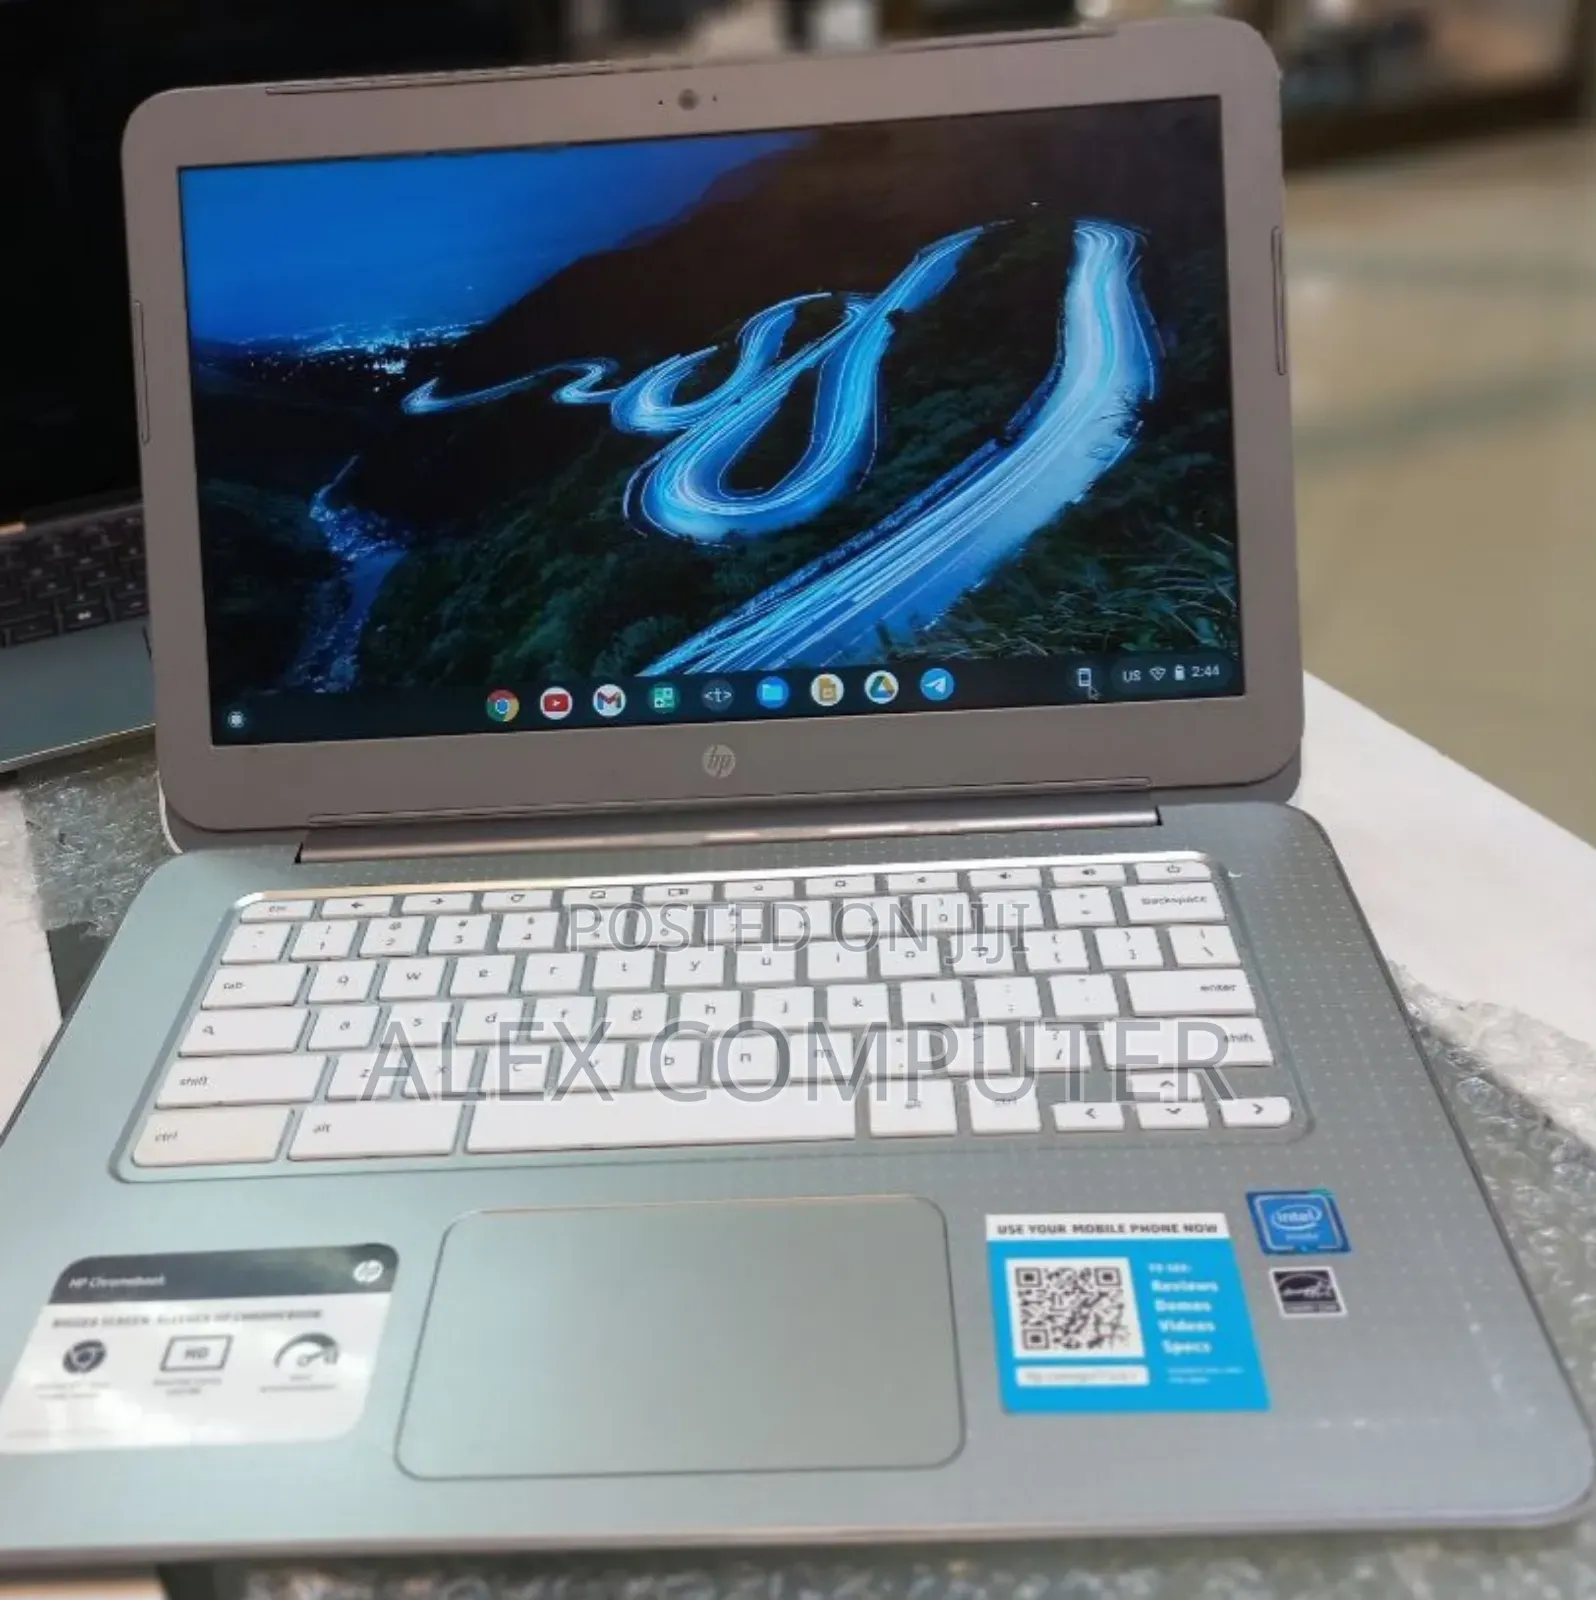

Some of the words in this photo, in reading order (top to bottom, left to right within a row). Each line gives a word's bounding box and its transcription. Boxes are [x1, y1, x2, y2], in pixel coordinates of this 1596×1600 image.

[1122, 669, 1142, 683] US
[1191, 664, 1220, 678] 2:44
[703, 744, 736, 778] hp
[690, 960, 701, 971] y
[761, 956, 772, 966] u
[997, 1223, 1024, 1235] USE
[1028, 1223, 1067, 1235] YOUR
[1072, 1222, 1125, 1234] MOBILE
[1130, 1222, 1180, 1233] PHONE
[1183, 1222, 1218, 1233] NOW
[1150, 1279, 1219, 1292] Reviews
[1154, 1298, 1212, 1312] Demos
[1157, 1318, 1216, 1332] Videos
[1162, 1339, 1213, 1356] Specs
